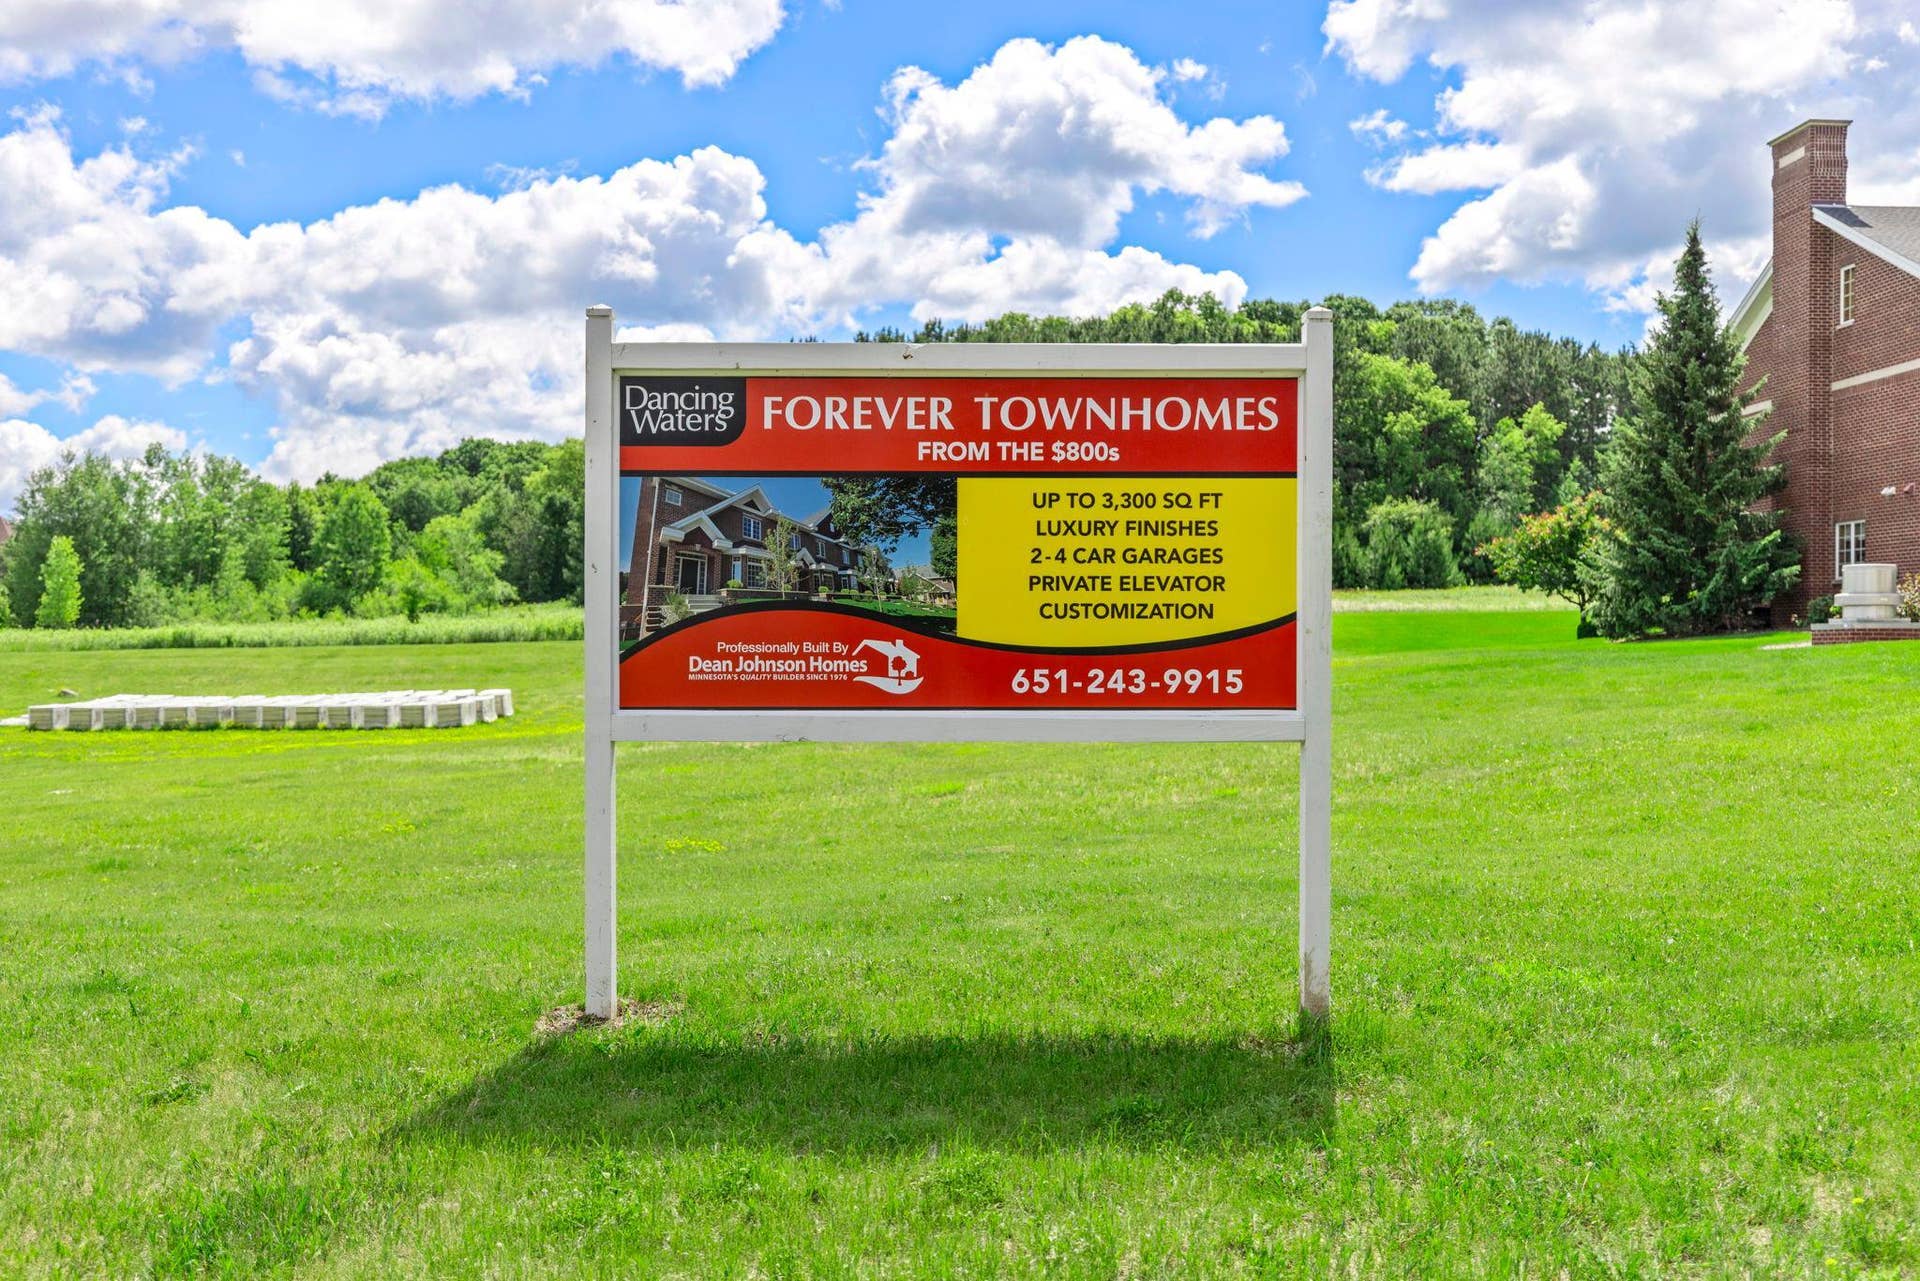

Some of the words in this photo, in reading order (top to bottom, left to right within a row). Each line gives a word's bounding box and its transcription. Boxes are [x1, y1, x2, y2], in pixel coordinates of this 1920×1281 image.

[625, 385, 735, 418] Dancing
[631, 409, 727, 434] Waters
[763, 396, 955, 430] FOREVER
[974, 396, 1278, 431] TOWNHOMES
[918, 441, 990, 461] FROM
[997, 442, 1044, 461] THE
[1051, 440, 1120, 462] $800s
[1032, 493, 1060, 508] UP
[1066, 493, 1095, 508] TO
[1102, 493, 1156, 511] 3,300
[1162, 493, 1192, 508] SQ
[1200, 493, 1223, 508] FT
[1036, 520, 1118, 536] LUXURY
[1125, 520, 1218, 536] FINISHES
[1073, 548, 1116, 564] CAR
[1122, 548, 1223, 564] GARAGES
[1029, 576, 1112, 591] PRIVATE
[1119, 576, 1225, 591] ELEVATOR
[1039, 603, 1214, 619] CUSTOMIZATION
[717, 642, 799, 655] Professionally
[803, 642, 829, 653] Built
[833, 642, 849, 655] By
[689, 656, 732, 672] Dean
[735, 656, 806, 672] Johnson
[810, 656, 868, 672] Homes
[1011, 669, 1243, 693] 651-243-9915
